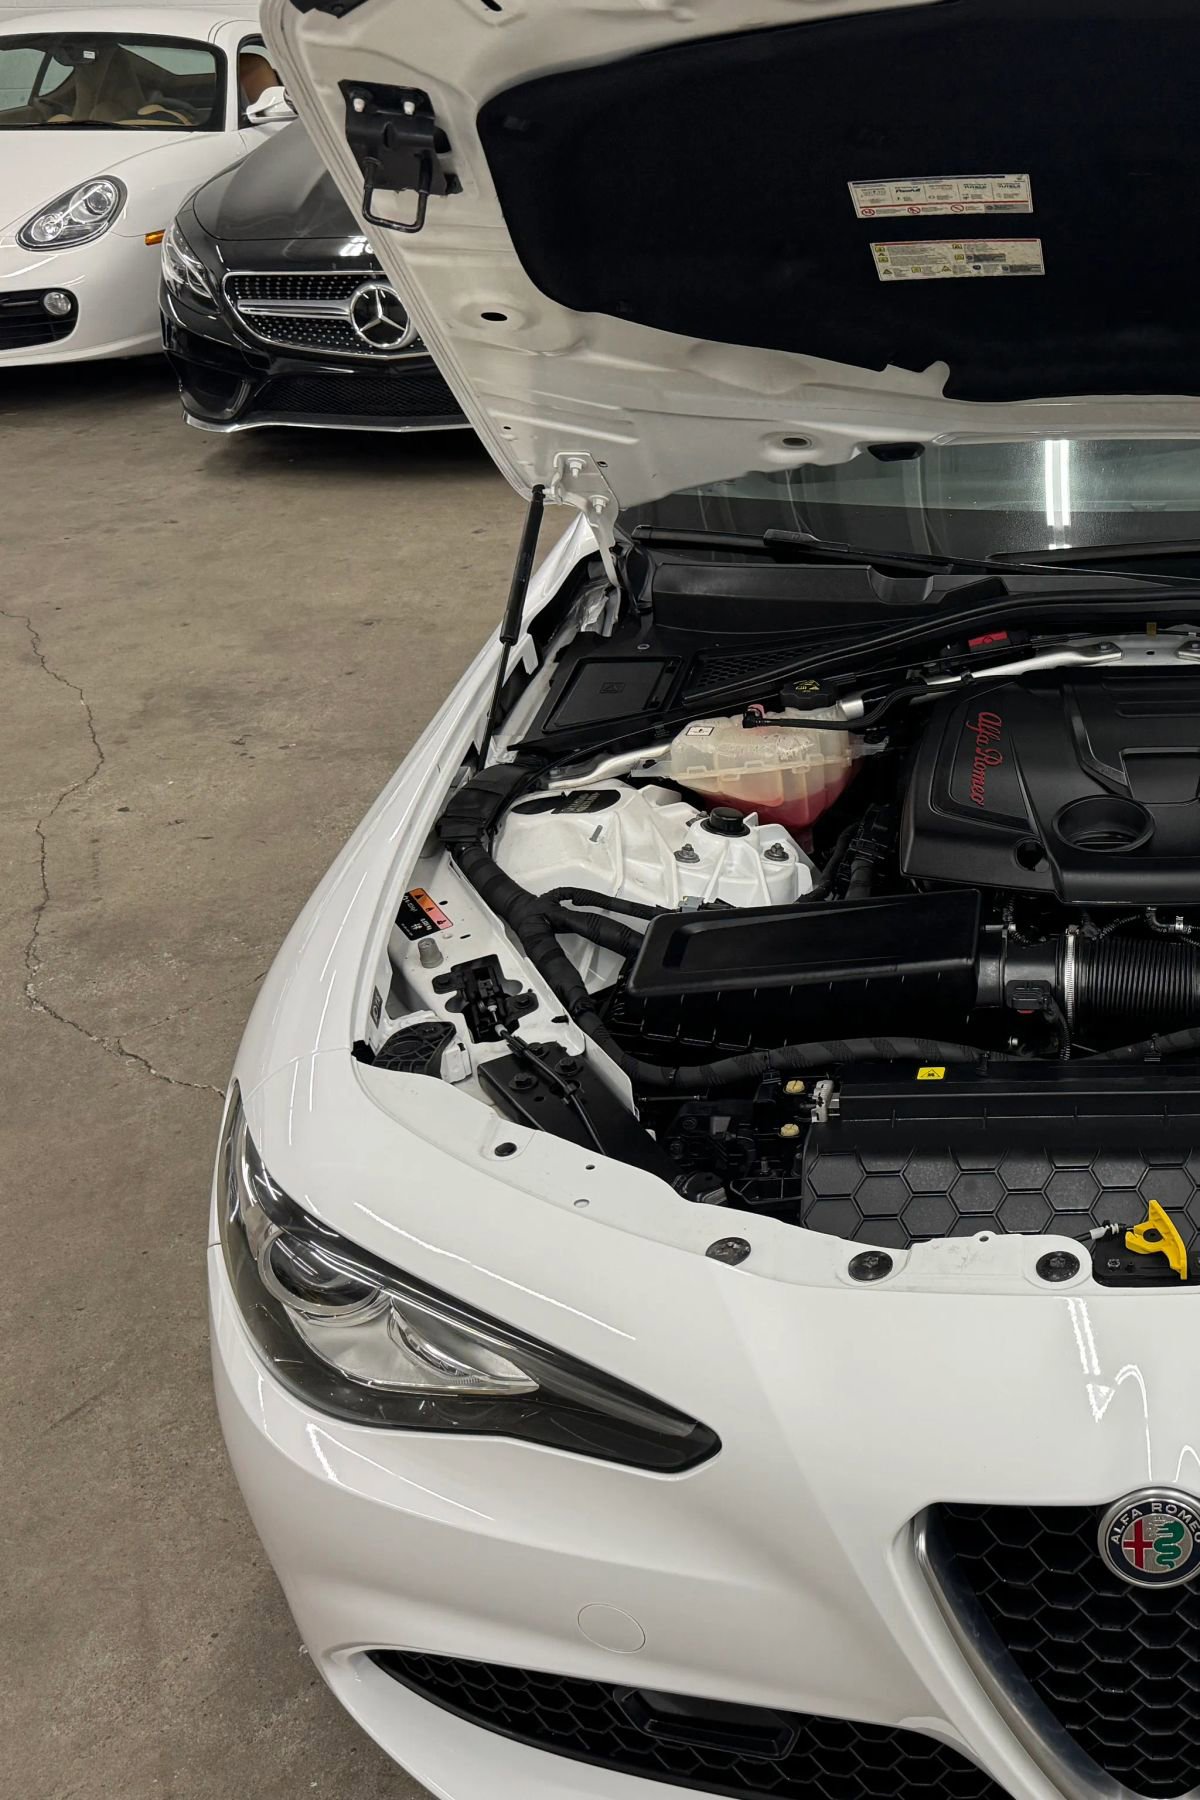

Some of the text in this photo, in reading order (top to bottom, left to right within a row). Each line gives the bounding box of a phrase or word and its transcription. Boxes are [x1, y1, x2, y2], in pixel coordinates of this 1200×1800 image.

[966, 711, 1003, 806] Alfa Romeo
[1111, 1508, 1142, 1544] ALFA
